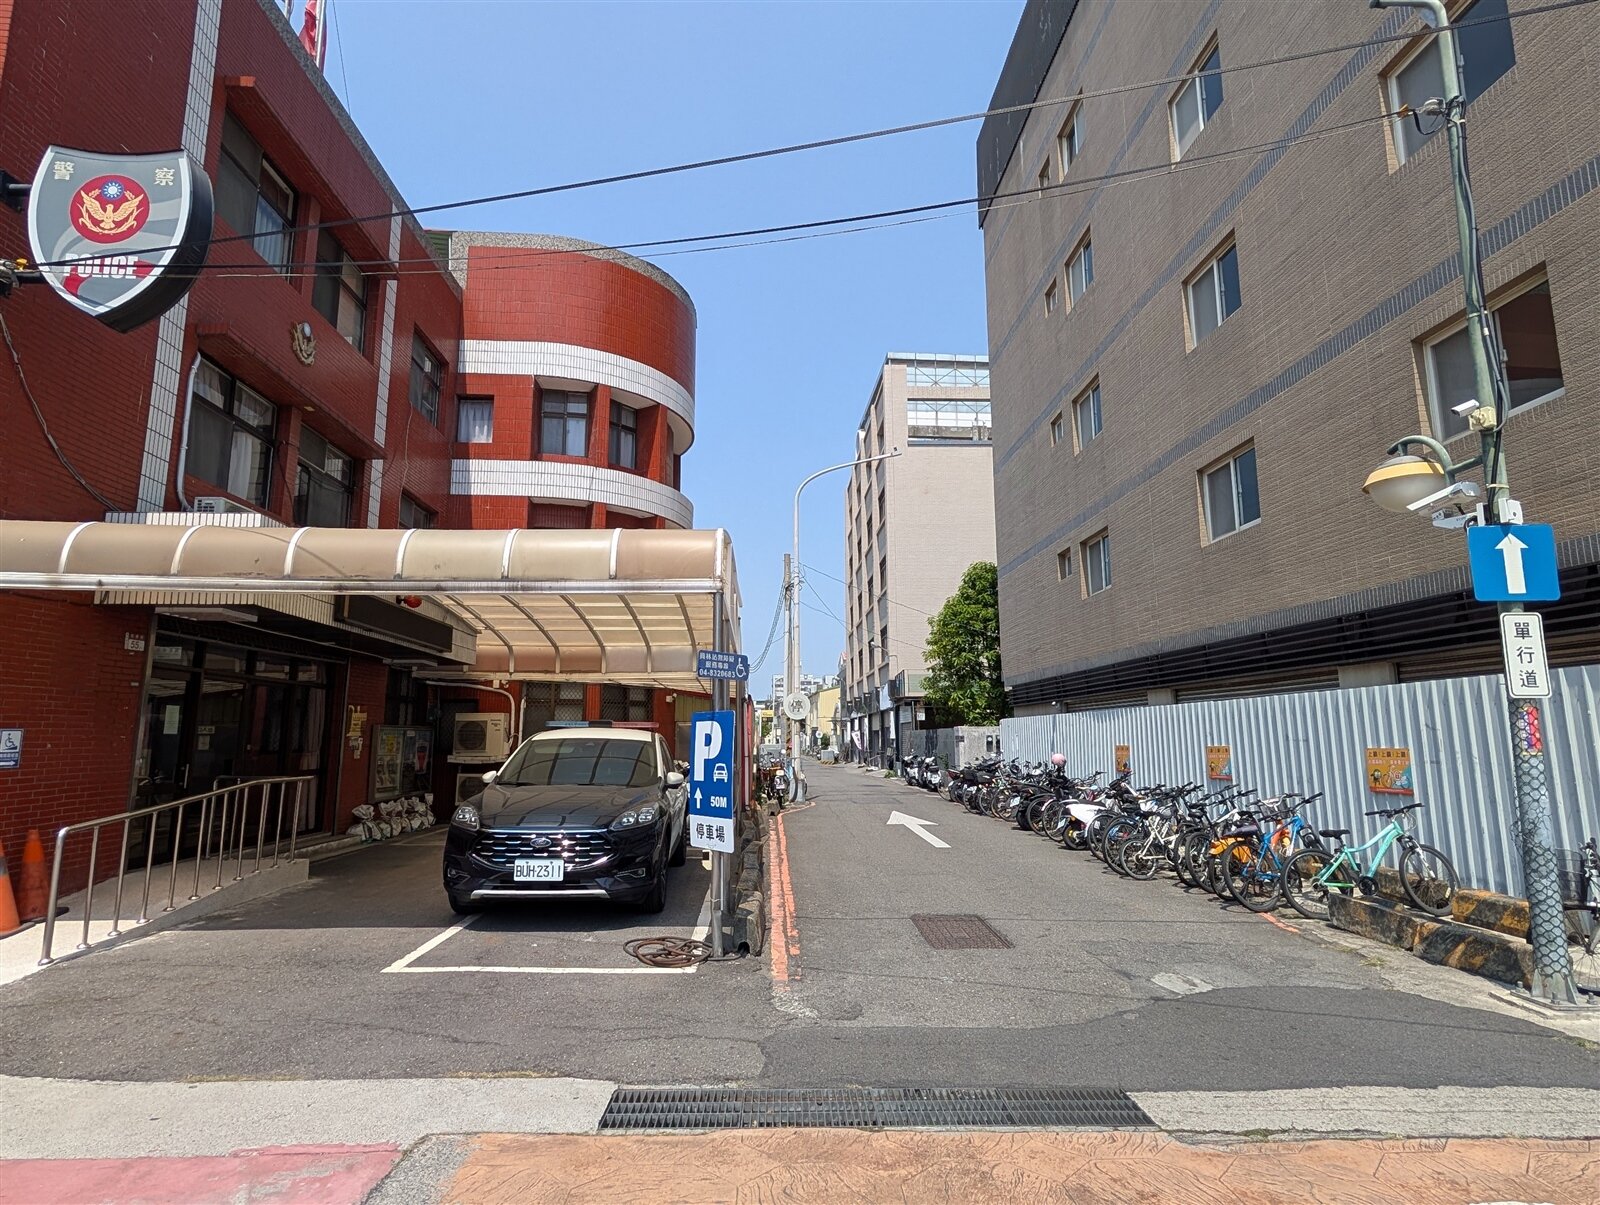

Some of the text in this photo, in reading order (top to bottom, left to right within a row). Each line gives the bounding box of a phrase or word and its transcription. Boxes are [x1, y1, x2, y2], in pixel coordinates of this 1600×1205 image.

[63, 253, 139, 279] POLICE
[1513, 621, 1540, 688] 單行道
[699, 668, 736, 678] 04-8320683
[694, 720, 722, 782] P
[710, 796, 727, 808] 50M
[696, 823, 725, 843] 停車場
[515, 865, 561, 878] BUH-2311
